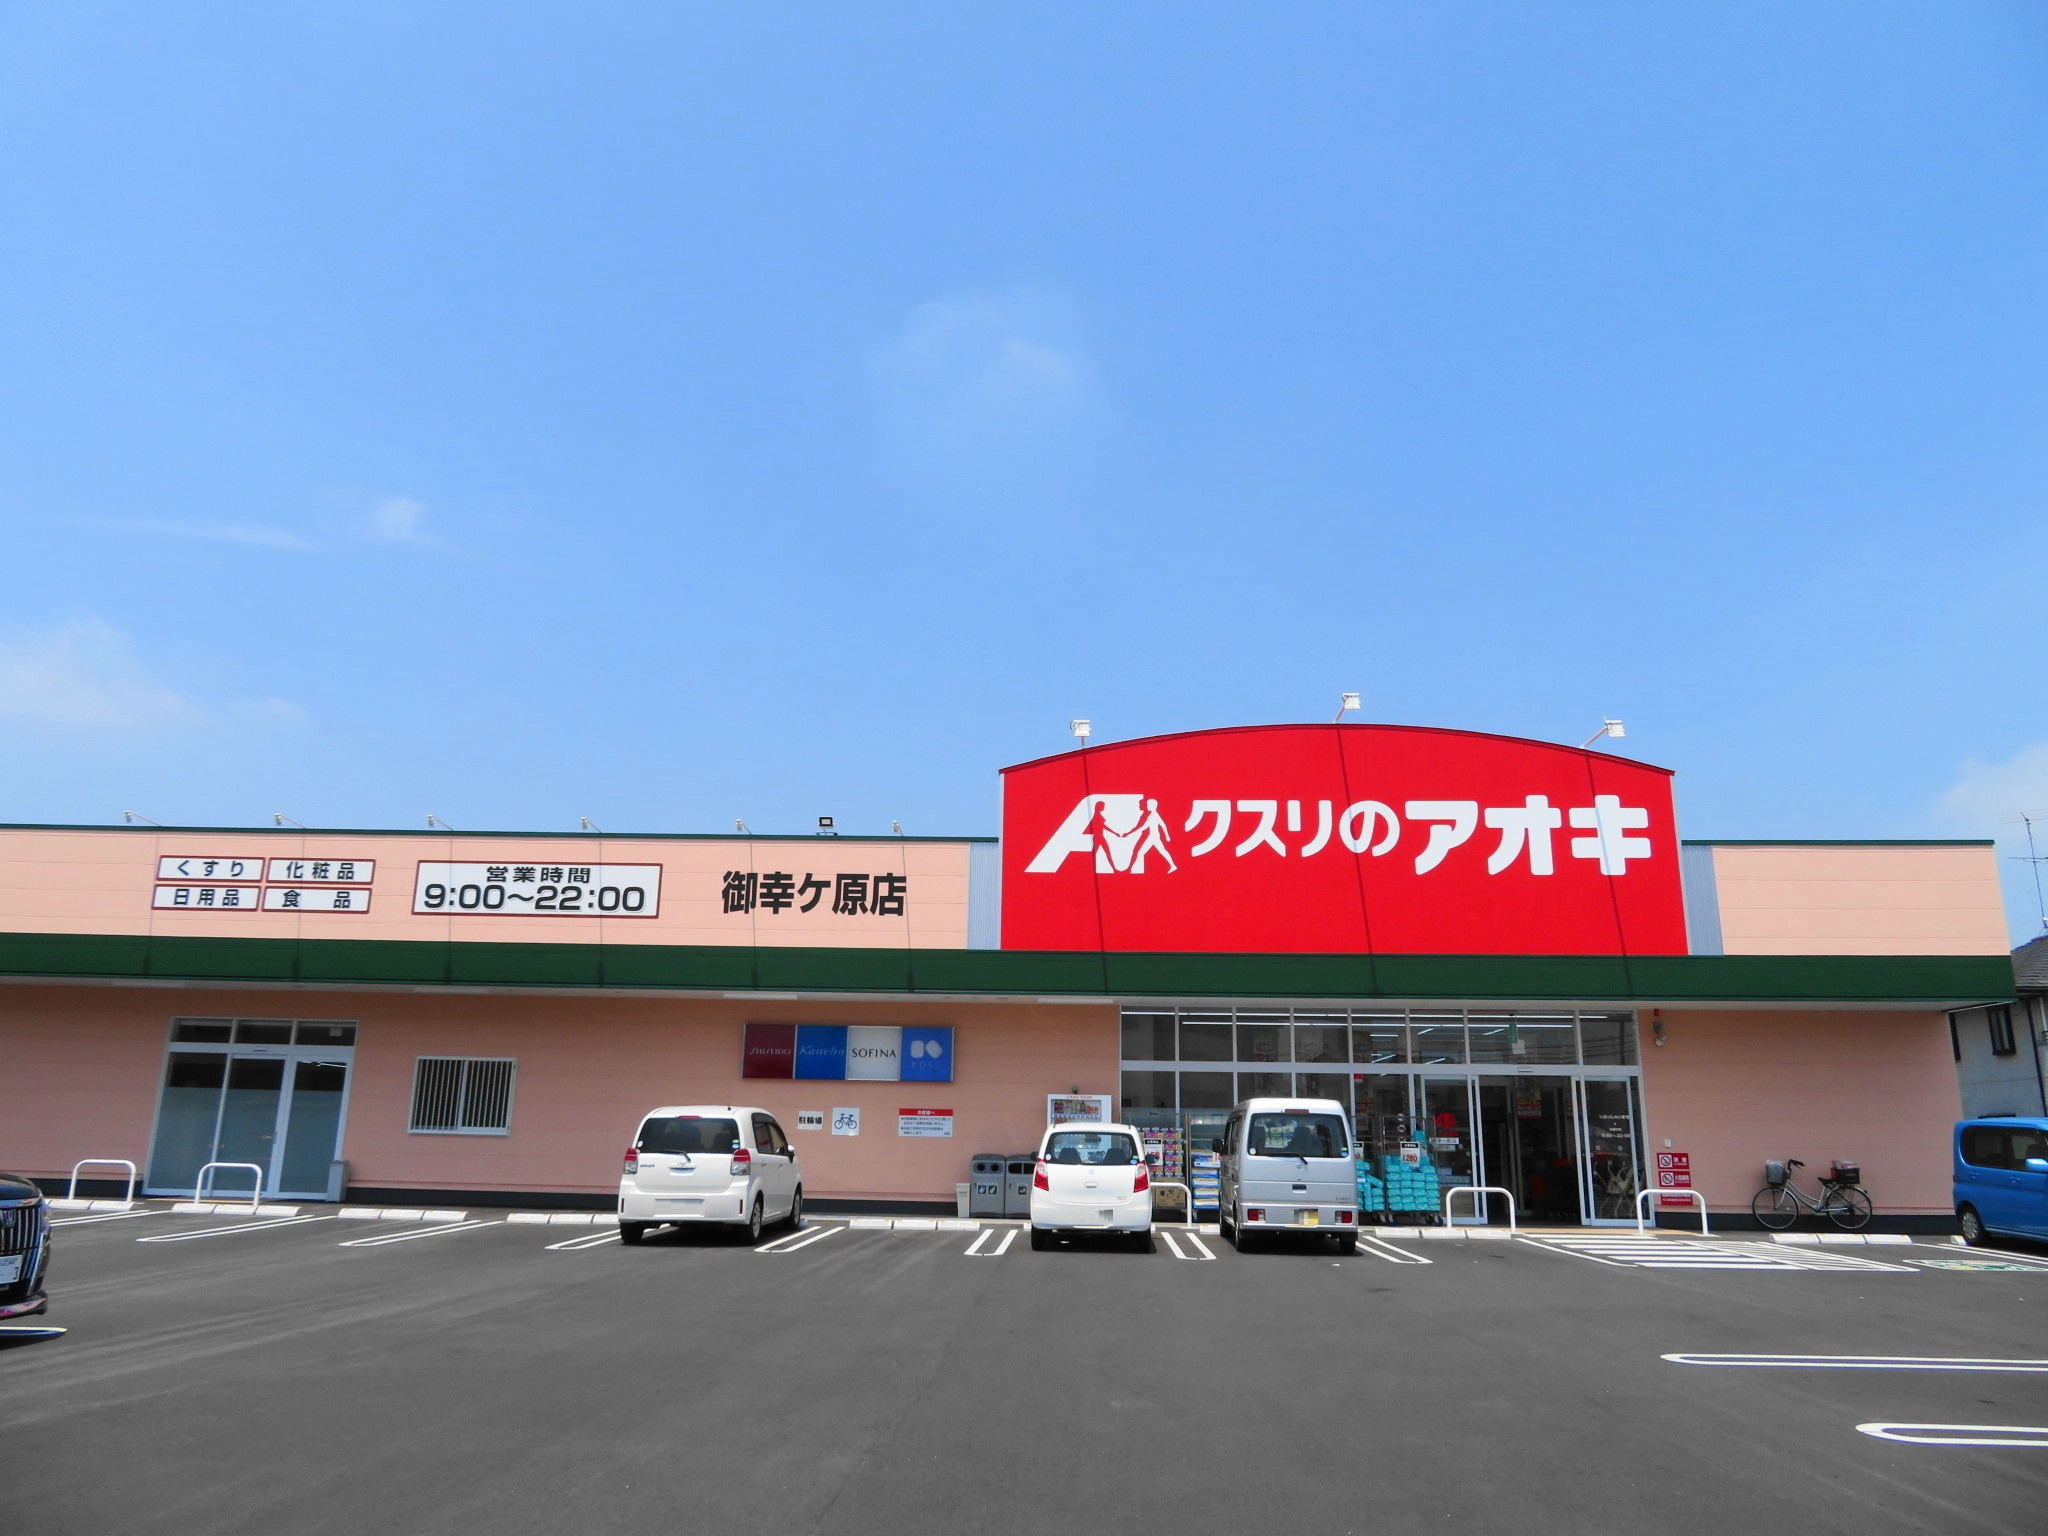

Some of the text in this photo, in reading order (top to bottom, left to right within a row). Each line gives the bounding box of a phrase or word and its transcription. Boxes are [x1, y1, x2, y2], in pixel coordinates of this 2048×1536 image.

[1184, 794, 1652, 875] クスリのアオキ
[177, 860, 244, 877] くすり
[286, 861, 355, 880] 化粧品
[486, 866, 591, 884] 営業時間
[173, 888, 239, 906] 日用品
[282, 889, 351, 908] 食品
[852, 1048, 897, 1058] SOFINA
